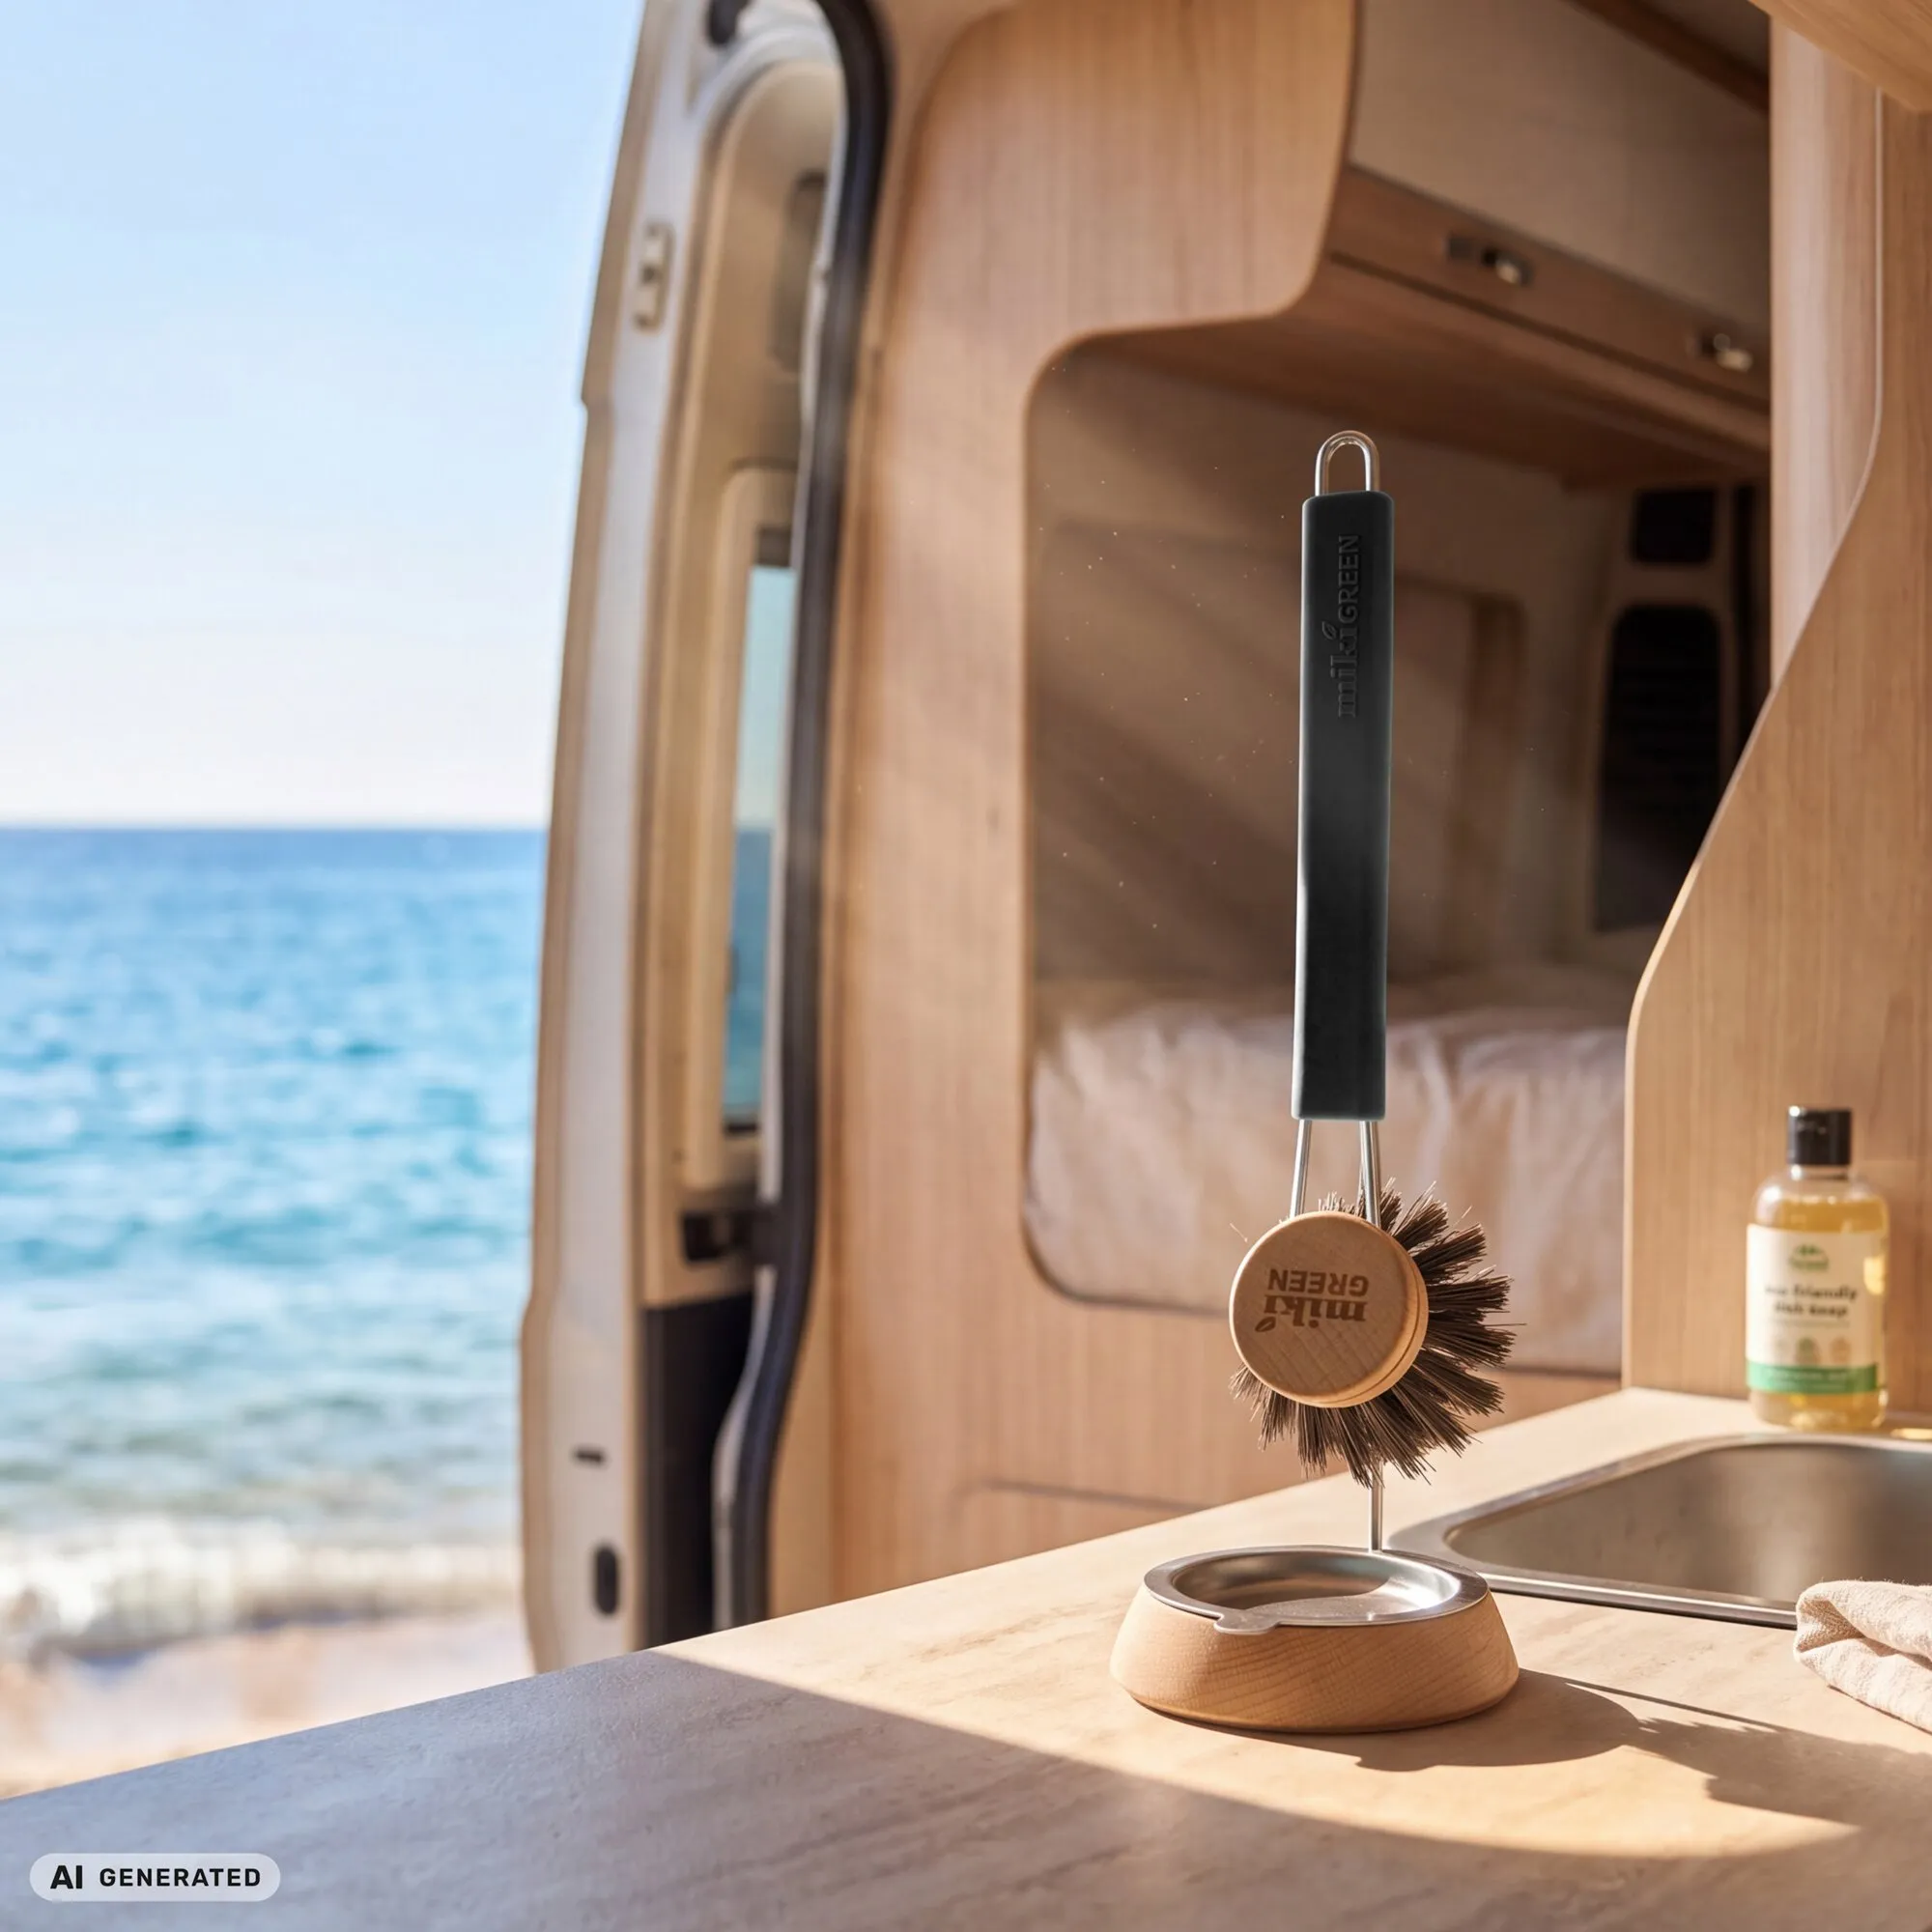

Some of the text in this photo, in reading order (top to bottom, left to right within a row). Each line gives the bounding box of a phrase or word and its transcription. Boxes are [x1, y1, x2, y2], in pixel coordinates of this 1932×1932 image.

[1322, 534, 1360, 718] miki GREEN
[1267, 1268, 1369, 1296] GREEN
[1255, 1294, 1368, 1332] miki
